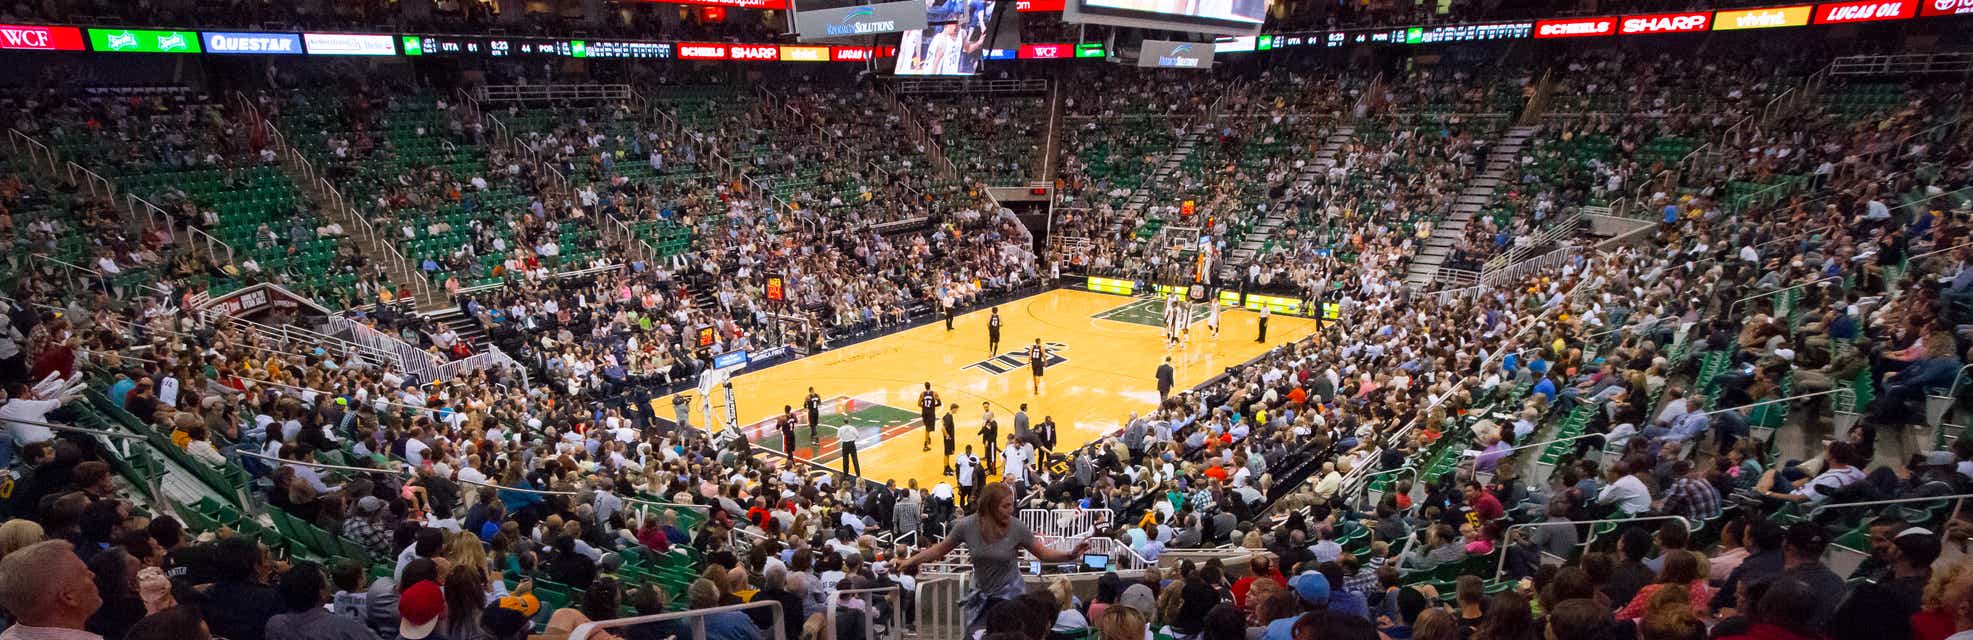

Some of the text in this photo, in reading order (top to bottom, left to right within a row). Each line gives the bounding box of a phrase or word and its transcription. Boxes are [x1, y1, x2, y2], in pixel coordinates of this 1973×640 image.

[1826, 2, 1903, 21] LUCAS OIL
[0, 28, 48, 47] WCF
[442, 43, 459, 51] UTA
[521, 45, 531, 53] 44
[539, 45, 554, 53] POR
